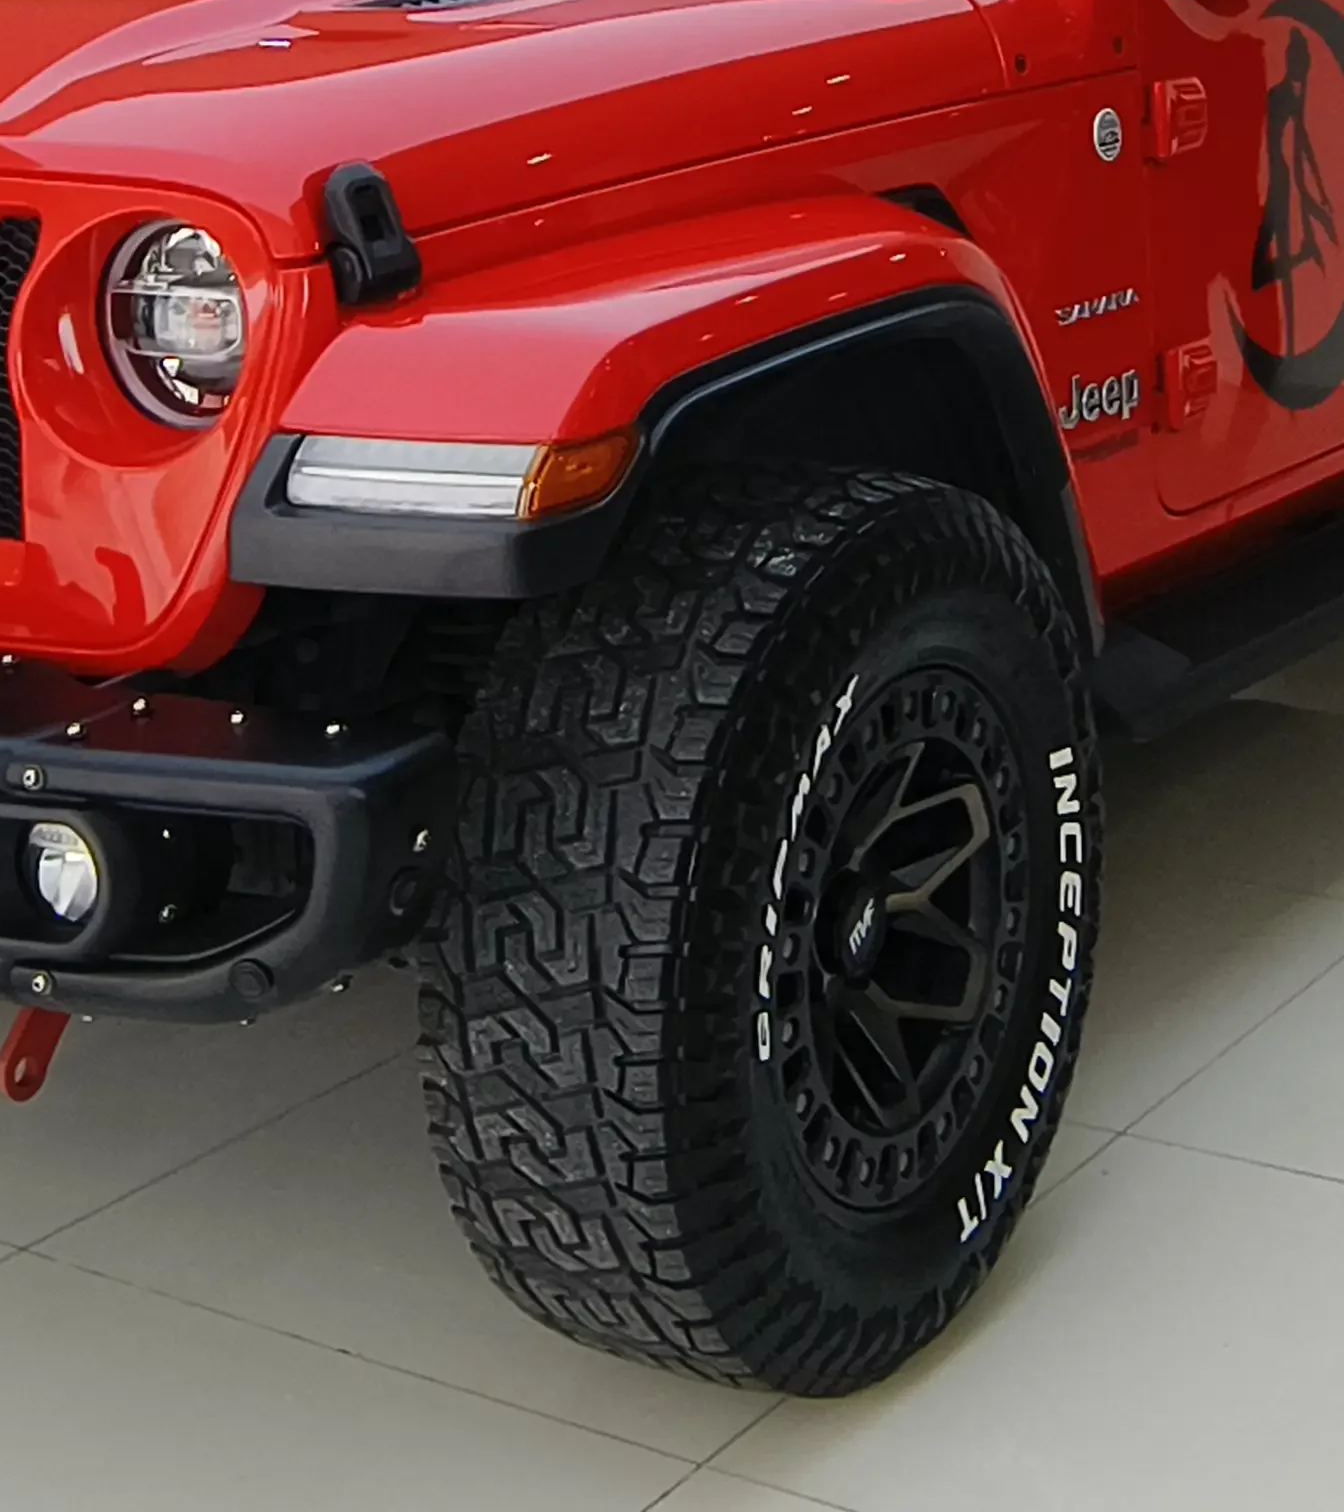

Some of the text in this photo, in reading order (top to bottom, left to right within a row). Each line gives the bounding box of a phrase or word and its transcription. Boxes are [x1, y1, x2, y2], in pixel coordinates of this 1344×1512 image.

[1058, 368, 1139, 429] Jeep
[956, 746, 1082, 1244] INCEPTION X/T
